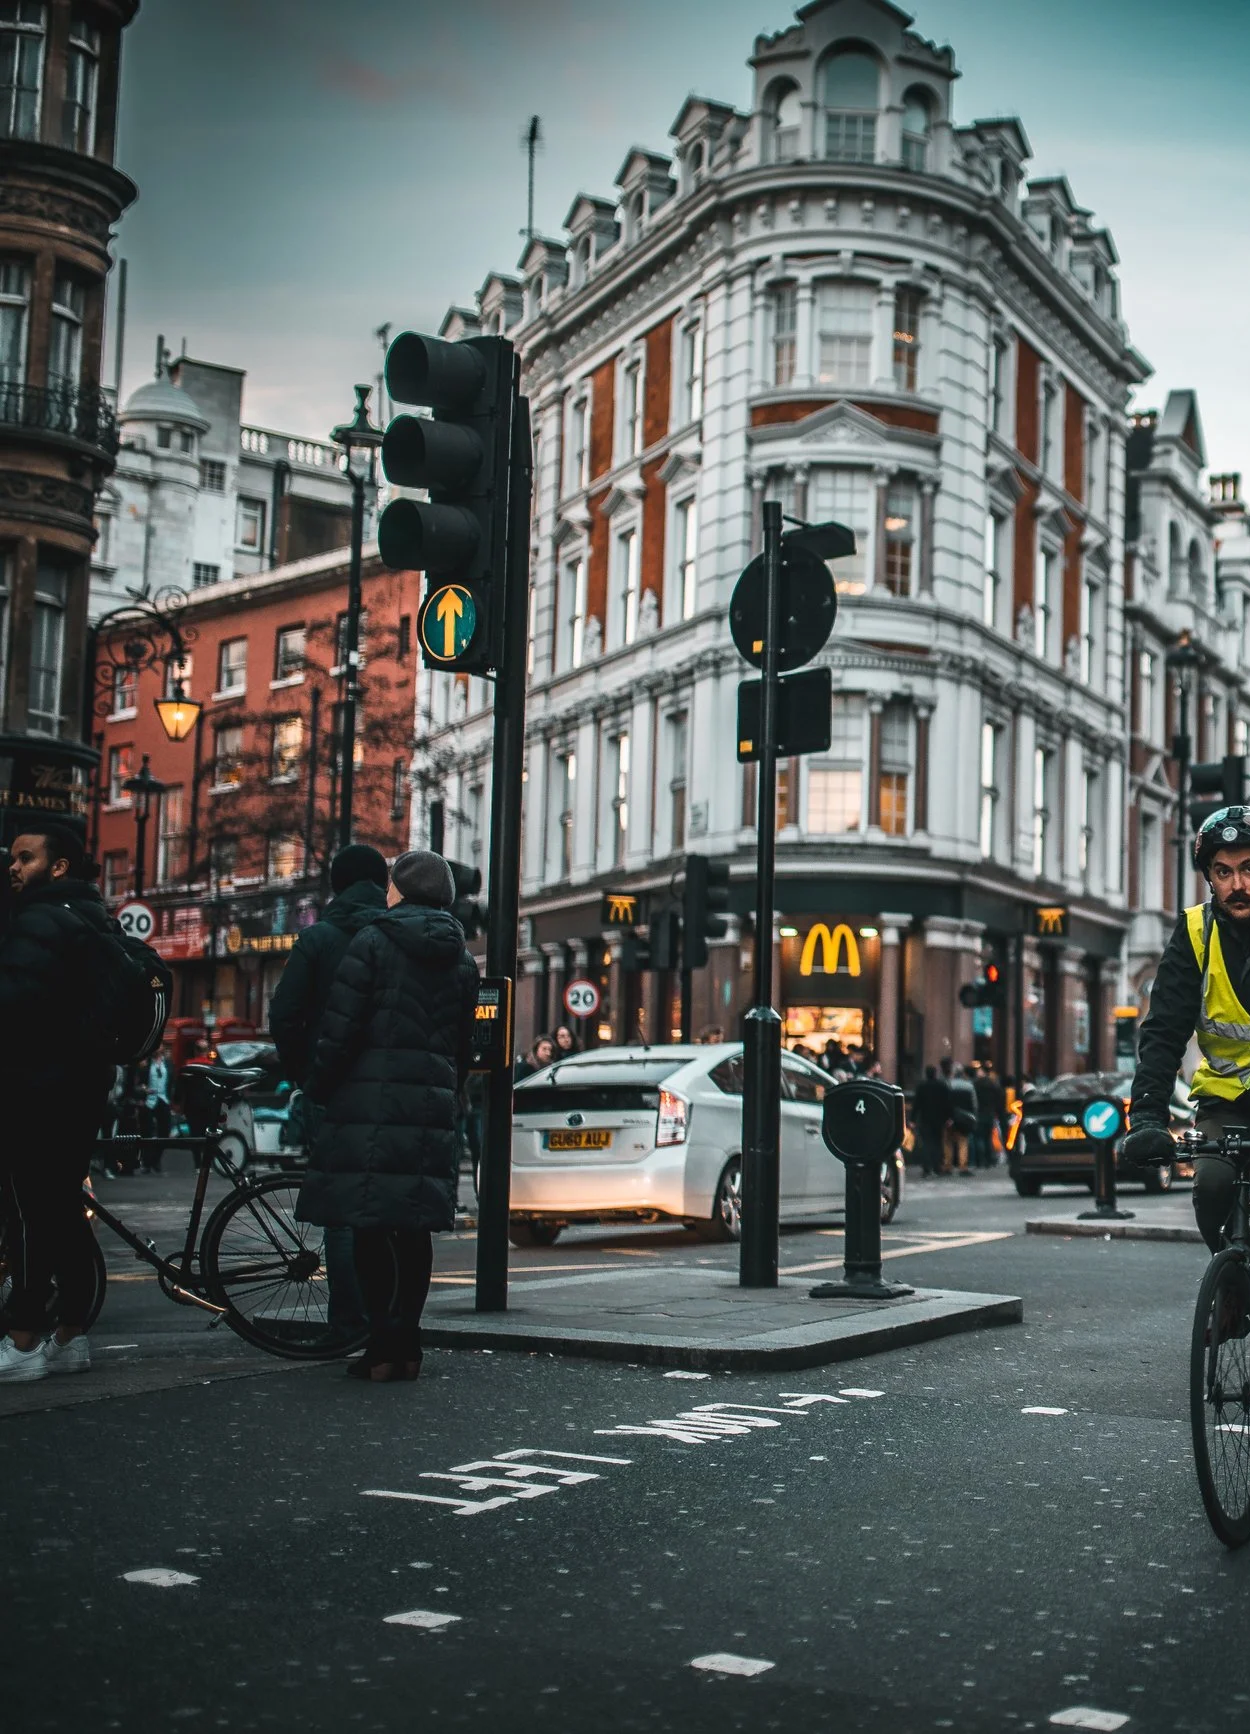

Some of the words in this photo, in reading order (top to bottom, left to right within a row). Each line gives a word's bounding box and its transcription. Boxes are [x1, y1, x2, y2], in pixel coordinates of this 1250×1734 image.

[120, 912, 150, 933] 20
[570, 989, 595, 1008] 20
[475, 1006, 497, 1019] AIT
[855, 1100, 866, 1115] 4
[593, 1402, 809, 1443] LOOK
[359, 1448, 634, 1515] LEFT
